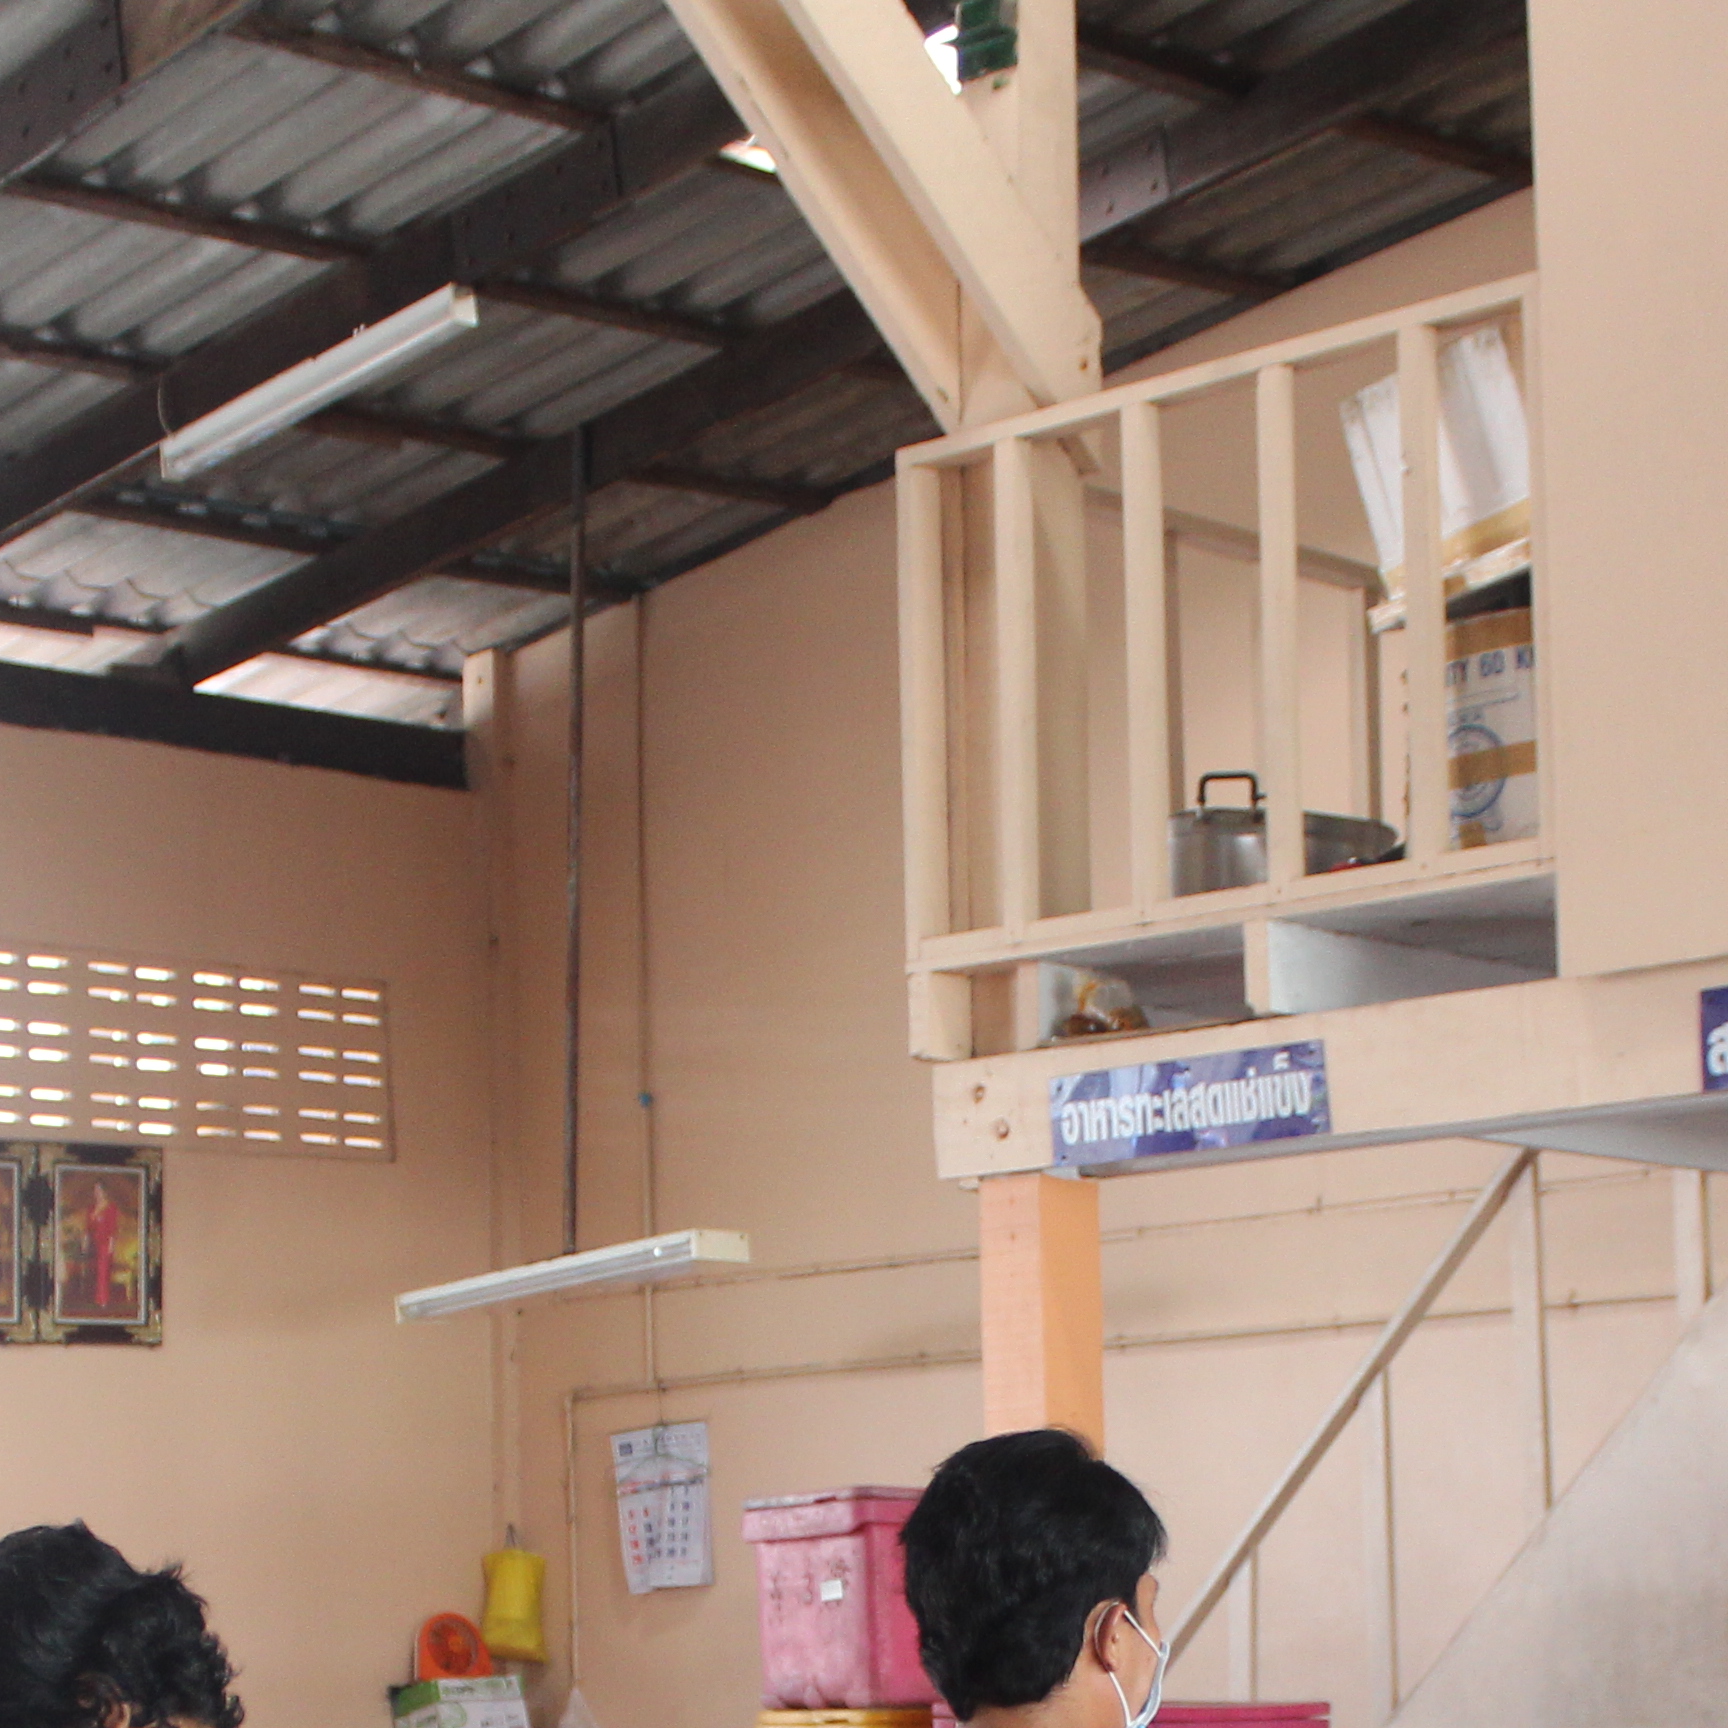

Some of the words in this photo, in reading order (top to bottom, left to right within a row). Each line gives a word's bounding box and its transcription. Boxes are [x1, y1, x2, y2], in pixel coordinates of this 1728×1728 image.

[1060, 1051, 1314, 1146] อาหารทะเลสดแช่แข็ง
